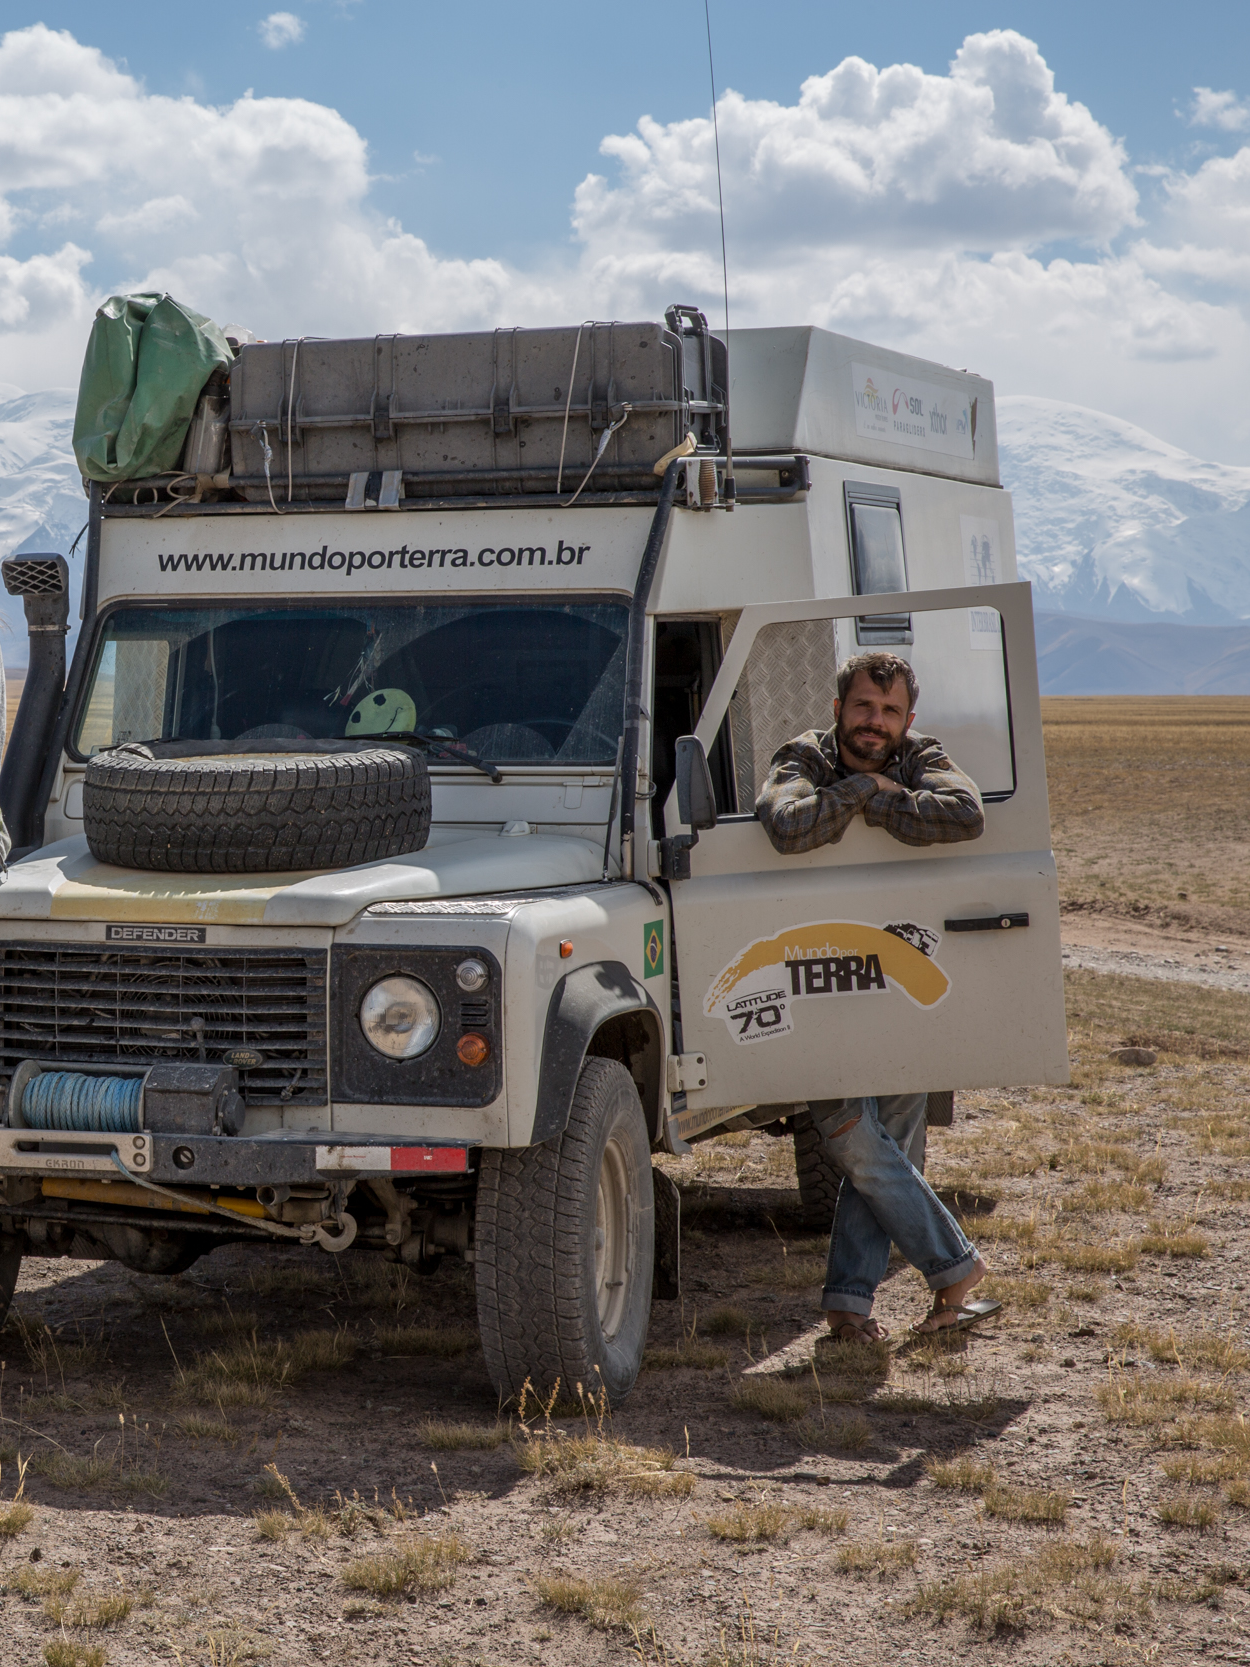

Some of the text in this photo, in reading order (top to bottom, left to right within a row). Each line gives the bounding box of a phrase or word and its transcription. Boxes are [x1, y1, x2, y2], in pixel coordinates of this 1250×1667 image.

[854, 391, 888, 414] VICTORIA
[909, 396, 924, 417] SOL
[893, 420, 926, 438] PARAGLIDERS
[157, 540, 590, 576] www.mundoporterra.com.br
[111, 927, 199, 941] DEFENDER
[784, 942, 858, 961] Mundo por
[785, 954, 887, 996] TERRA
[726, 990, 787, 1012] LATITUDE
[744, 1033, 761, 1041] World
[761, 1027, 787, 1037] Expedition
[45, 1159, 85, 1169] EKRON
